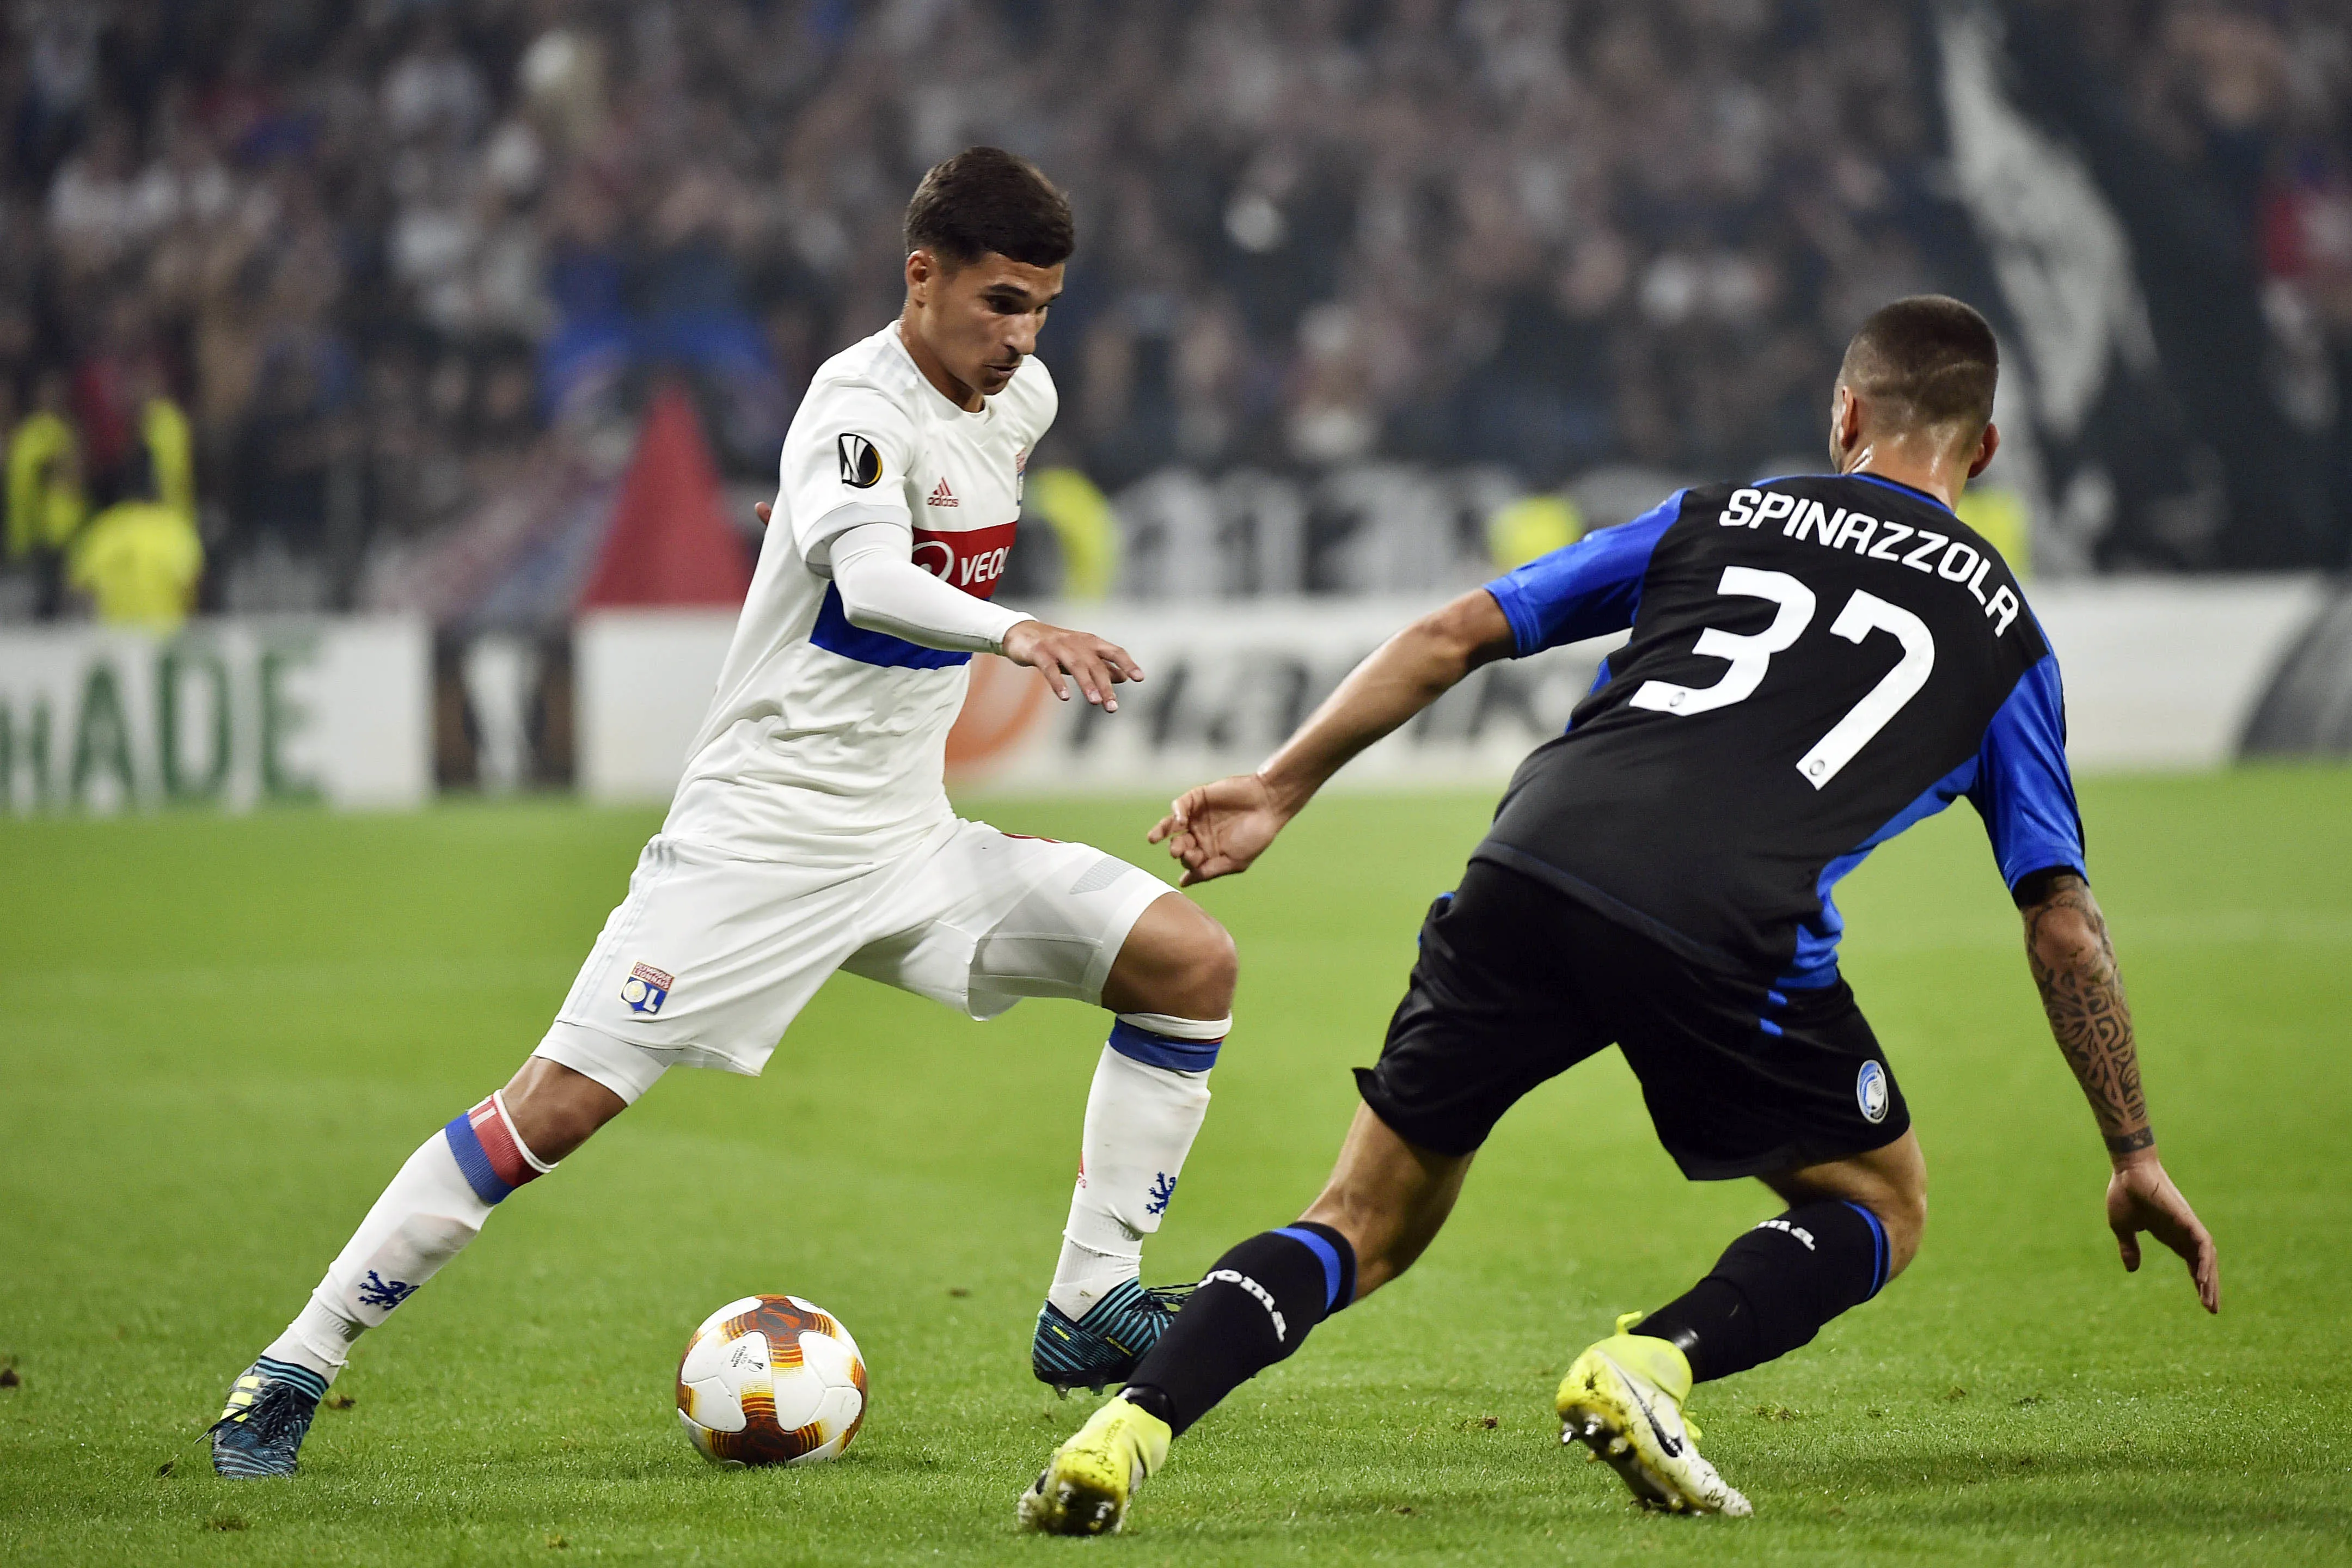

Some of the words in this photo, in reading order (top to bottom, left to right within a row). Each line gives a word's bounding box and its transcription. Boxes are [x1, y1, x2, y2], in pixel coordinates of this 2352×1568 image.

[927, 495, 959, 507] adidas
[1719, 488, 2019, 638] SPINAZZOLA
[1628, 566, 1935, 791] 37
